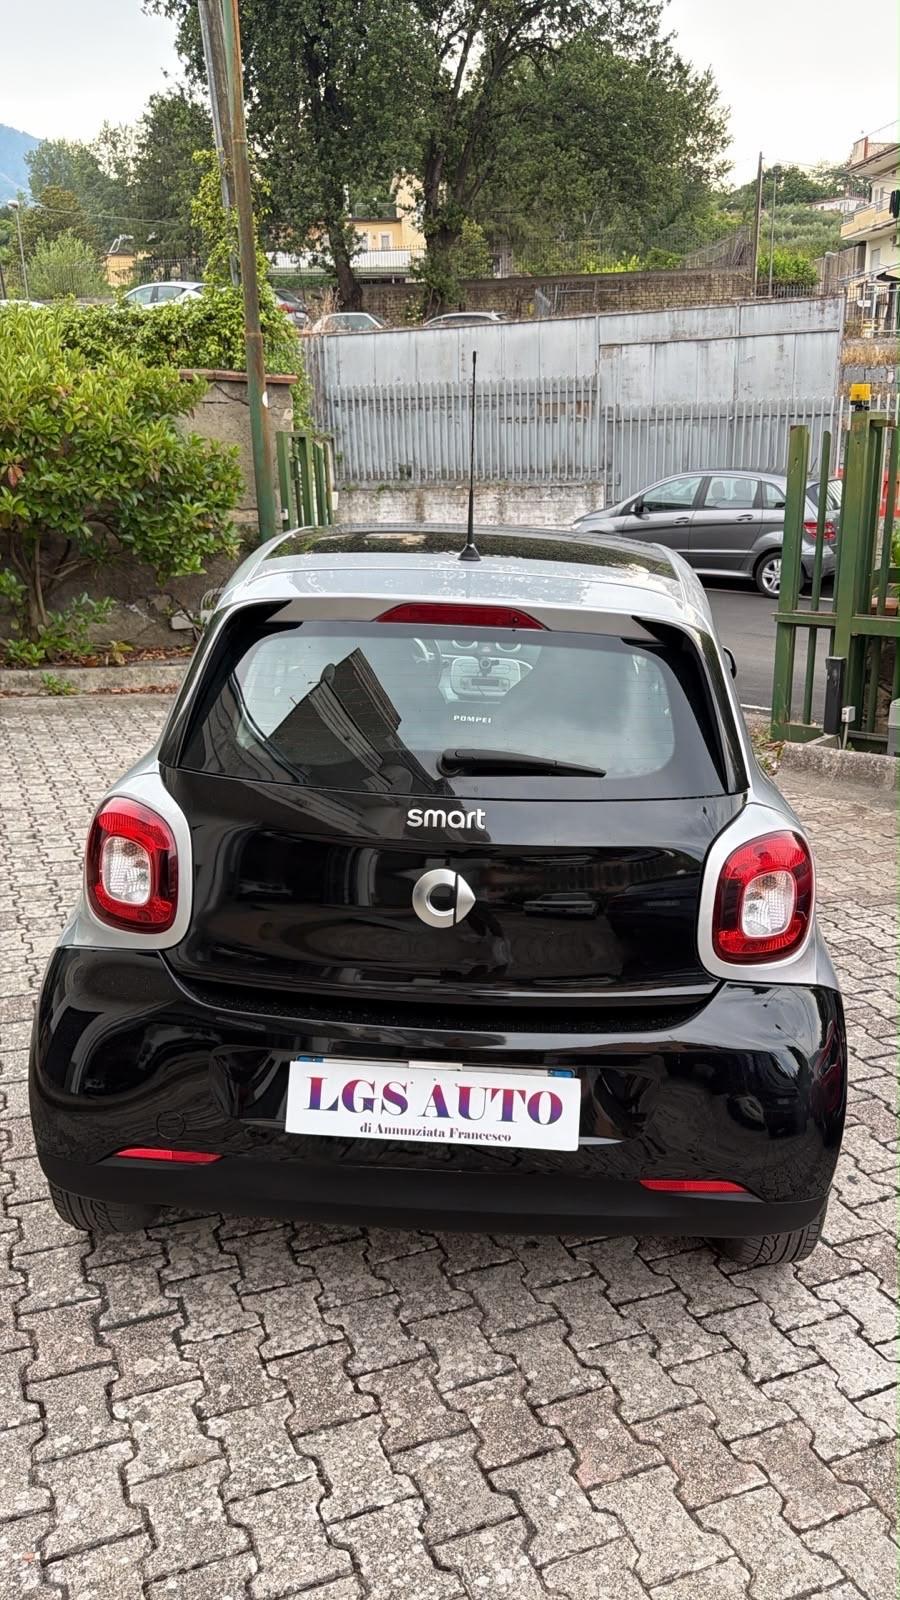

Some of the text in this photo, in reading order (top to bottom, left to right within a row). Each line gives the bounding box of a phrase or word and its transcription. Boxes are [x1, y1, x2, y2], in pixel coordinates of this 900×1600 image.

[453, 715, 492, 723] POMPEI
[406, 808, 486, 830] smart
[304, 1076, 563, 1125] LGS AUTO
[360, 1122, 512, 1142] di Annunziata Francesco
